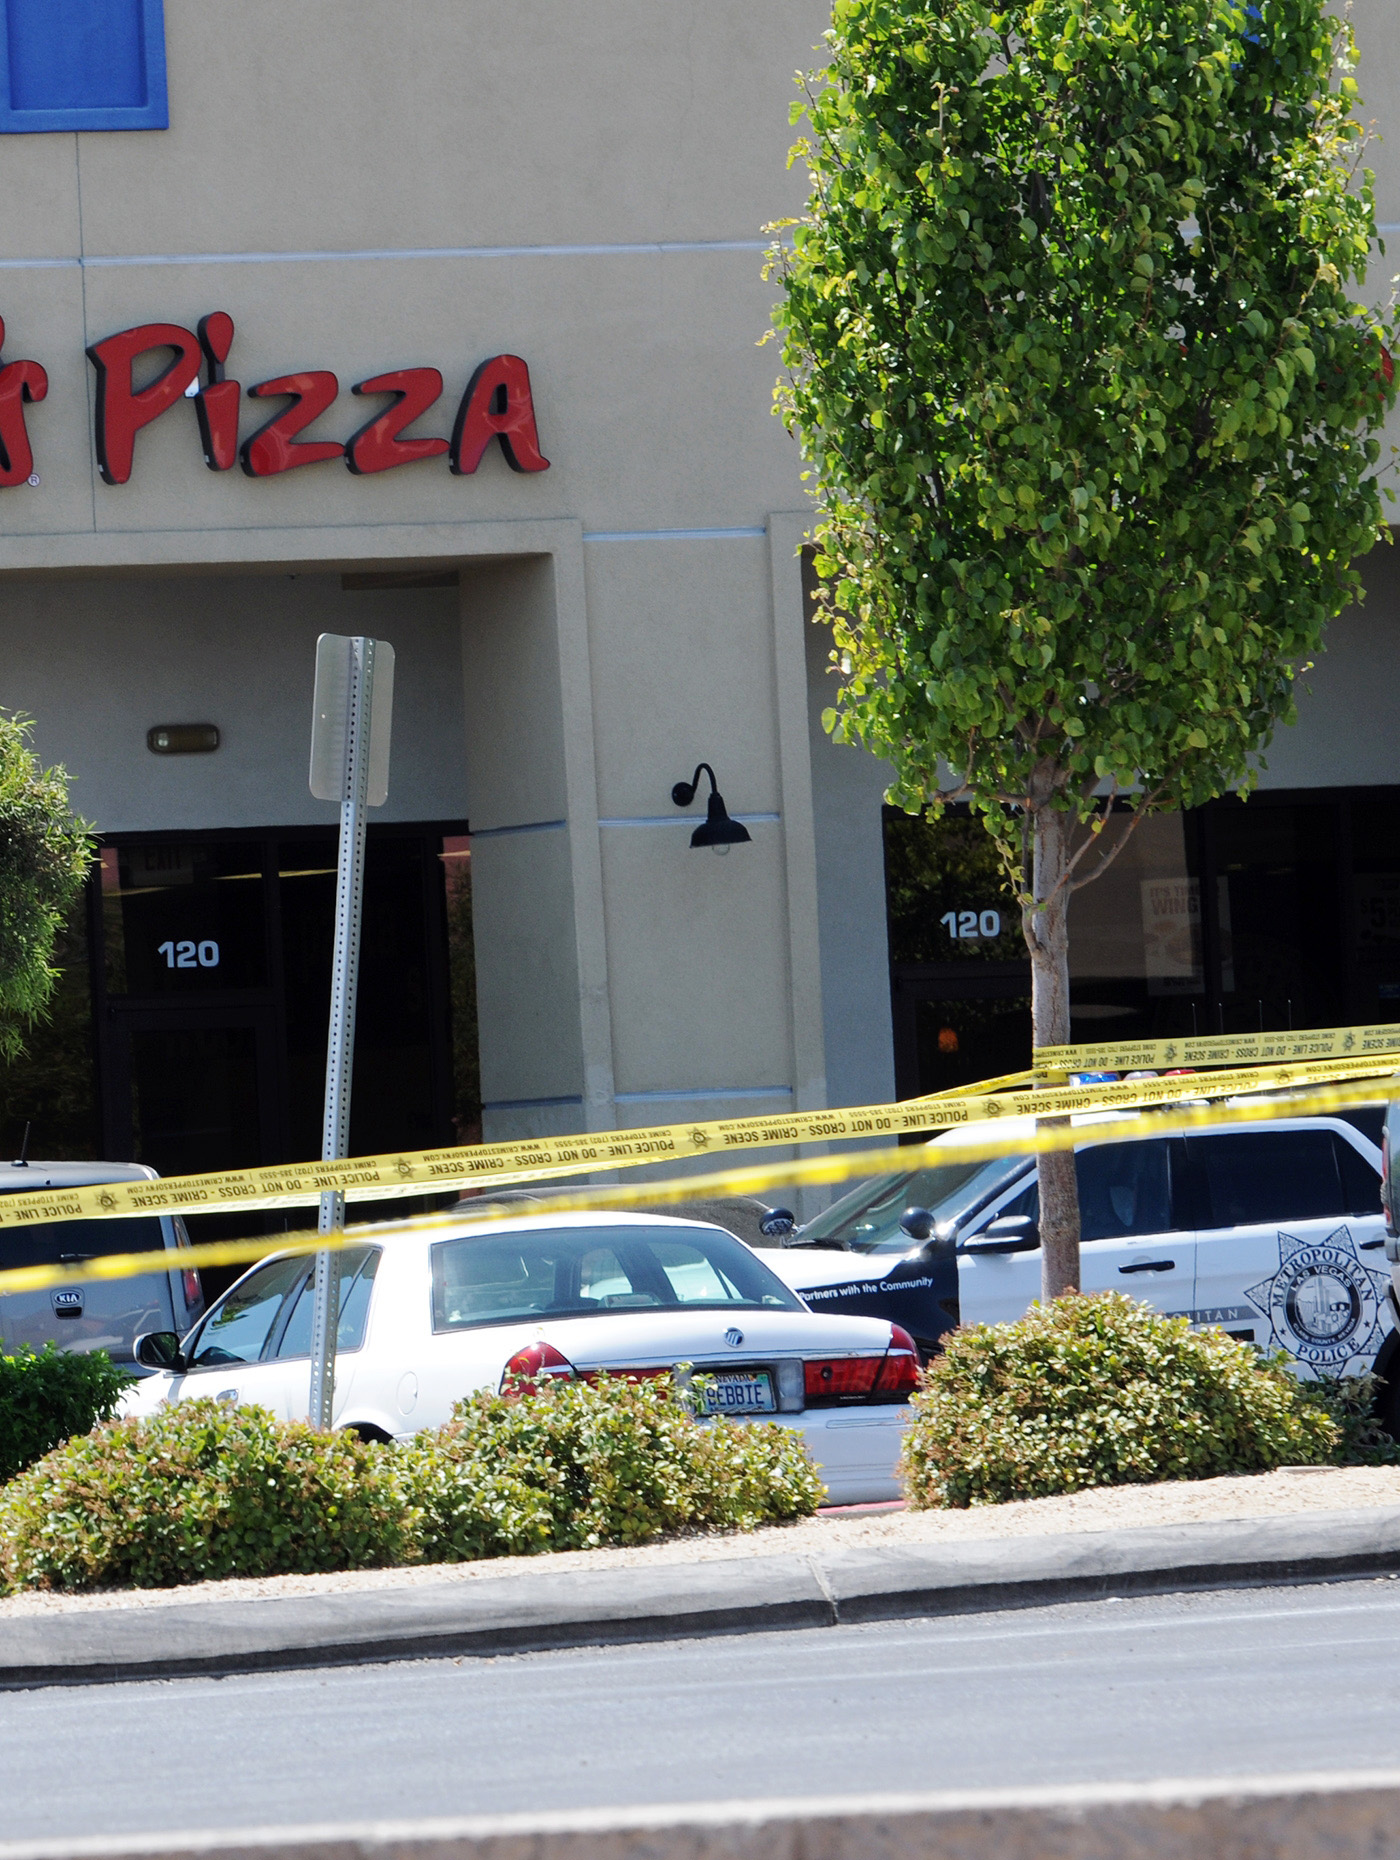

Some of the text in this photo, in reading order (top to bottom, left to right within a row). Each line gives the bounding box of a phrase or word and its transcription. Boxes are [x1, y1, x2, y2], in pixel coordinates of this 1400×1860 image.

[940, 910, 1000, 938] 120
[157, 940, 219, 968] 120
[1362, 1039, 1384, 1050] SCENE
[1184, 1043, 1333, 1061] POLICE LINE DO NOT CROSS CRIME SCENE
[1085, 1054, 1155, 1067] POLICE LINE DO NOT
[1178, 1076, 1196, 1085] (702)
[1198, 1073, 1232, 1083] STOPPERS
[1236, 1072, 1259, 1080] CRIME
[1143, 1092, 1163, 1102] NOT
[1168, 1089, 1182, 1099] DO
[1194, 1085, 1216, 1096] LINE
[1055, 1099, 1090, 1110] CRIME
[1102, 1093, 1138, 1106] CROSS
[1017, 1102, 1052, 1115] SCENE
[719, 1101, 966, 1131] CRIME STOPPERS (702) 385-5555 WWW.CRIMESTOPPERSOFNV.COM
[724, 1110, 968, 1145] POLICE LINE DO NOT CROSS CRIME SCENE
[423, 1130, 672, 1162] CRIME STOPPERS (702) 385-5555 WWW.CRIMESTOPPERSOFNV.COM
[428, 1140, 674, 1175] POLICE LINE DO NOT CROSS CRIME SCENE
[127, 1160, 376, 1193] CRIME STOPPERS (702) 385-5555 WWW.CRIMESTOPPERSOFNV.COM
[131, 1171, 380, 1207] POLICE LINE DO NOT CROSS CRIME SCENE
[18, 1195, 53, 1206] STOPPERS
[57, 1193, 79, 1203] CRIME
[13, 1208, 38, 1220] LINE
[42, 1204, 82, 1218] POLICE
[1272, 1249, 1375, 1308] METROPOLITAN
[1290, 1265, 1352, 1292] LAS VEGAS
[799, 1276, 933, 1302] Partners with the Community
[59, 1294, 79, 1303] KIA
[1297, 1337, 1360, 1362] POLICE
